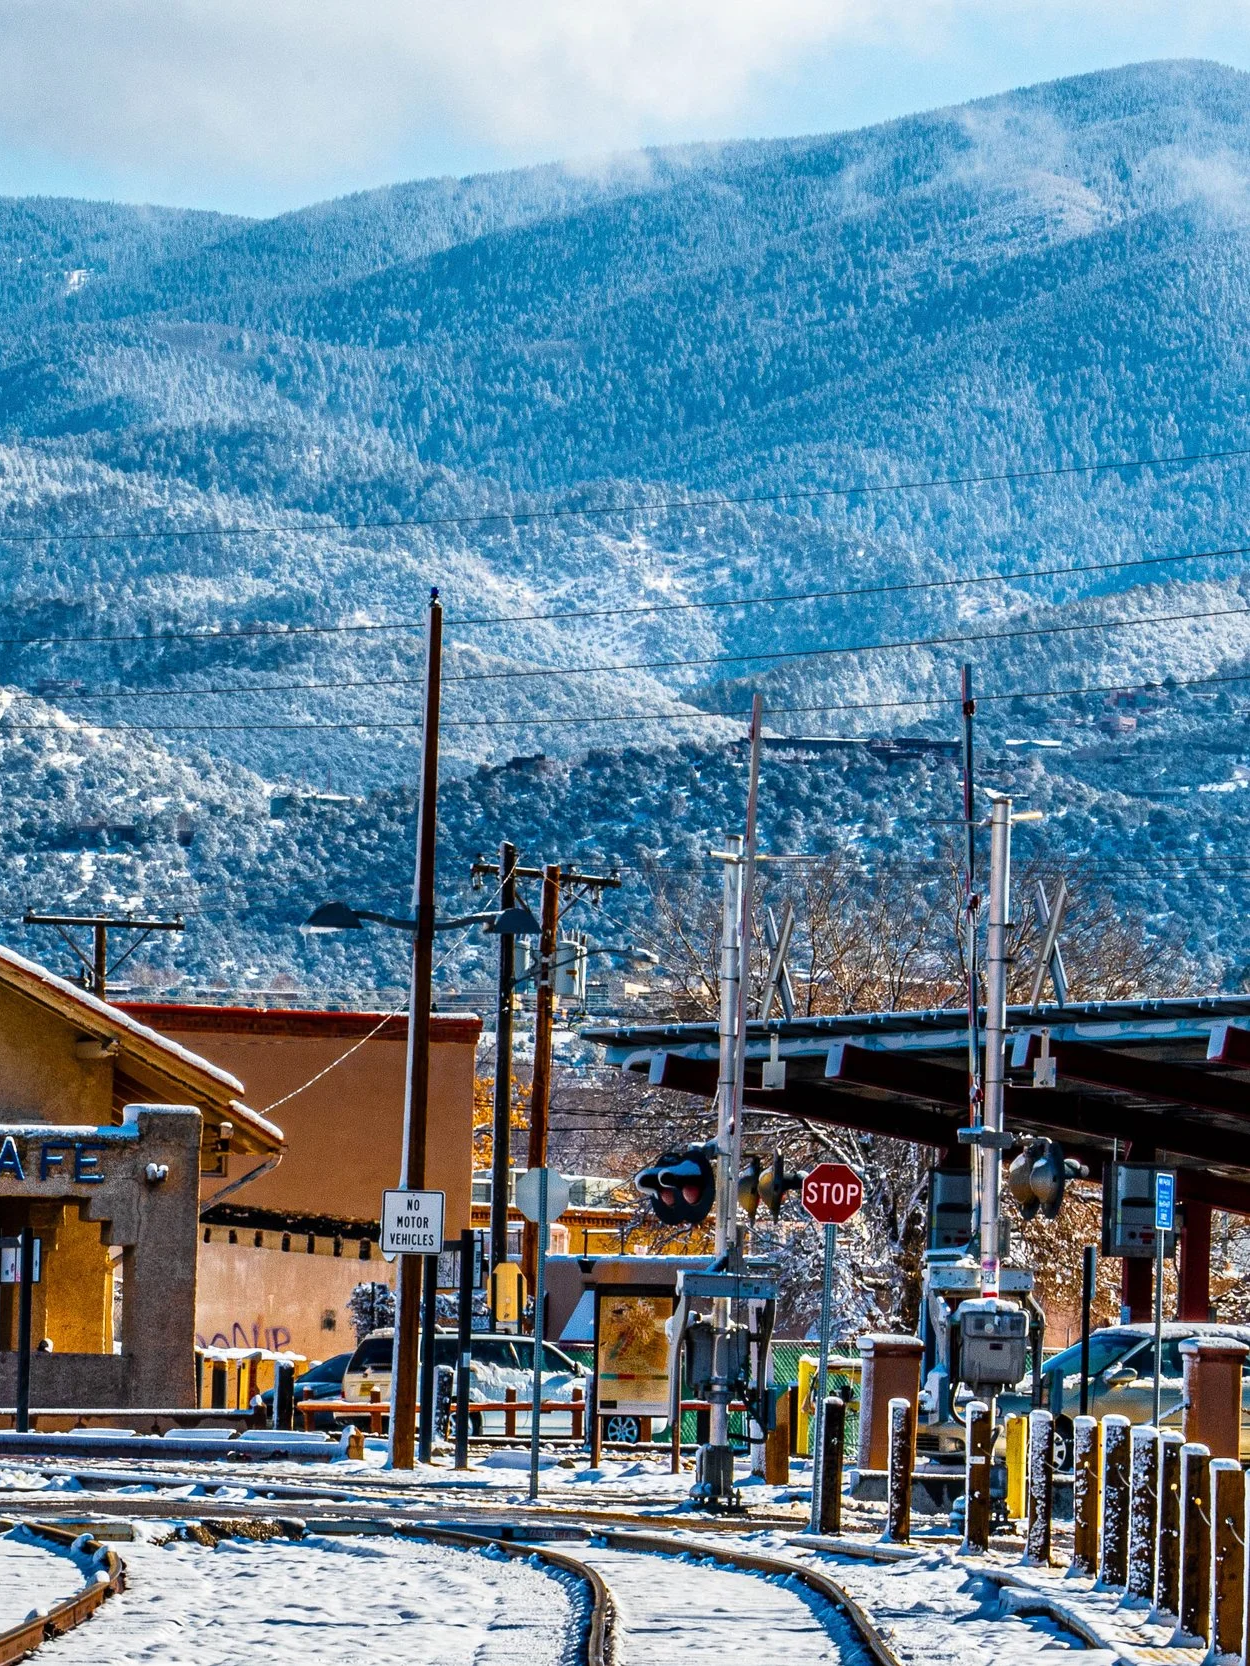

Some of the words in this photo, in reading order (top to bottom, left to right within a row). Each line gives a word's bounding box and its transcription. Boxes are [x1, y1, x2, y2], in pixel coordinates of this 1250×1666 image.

[41, 1142, 104, 1183] FE
[806, 1182, 859, 1205] STOP
[407, 1199, 420, 1211] NO
[396, 1216, 429, 1229] MOTOR
[390, 1233, 434, 1246] VEHICLES
